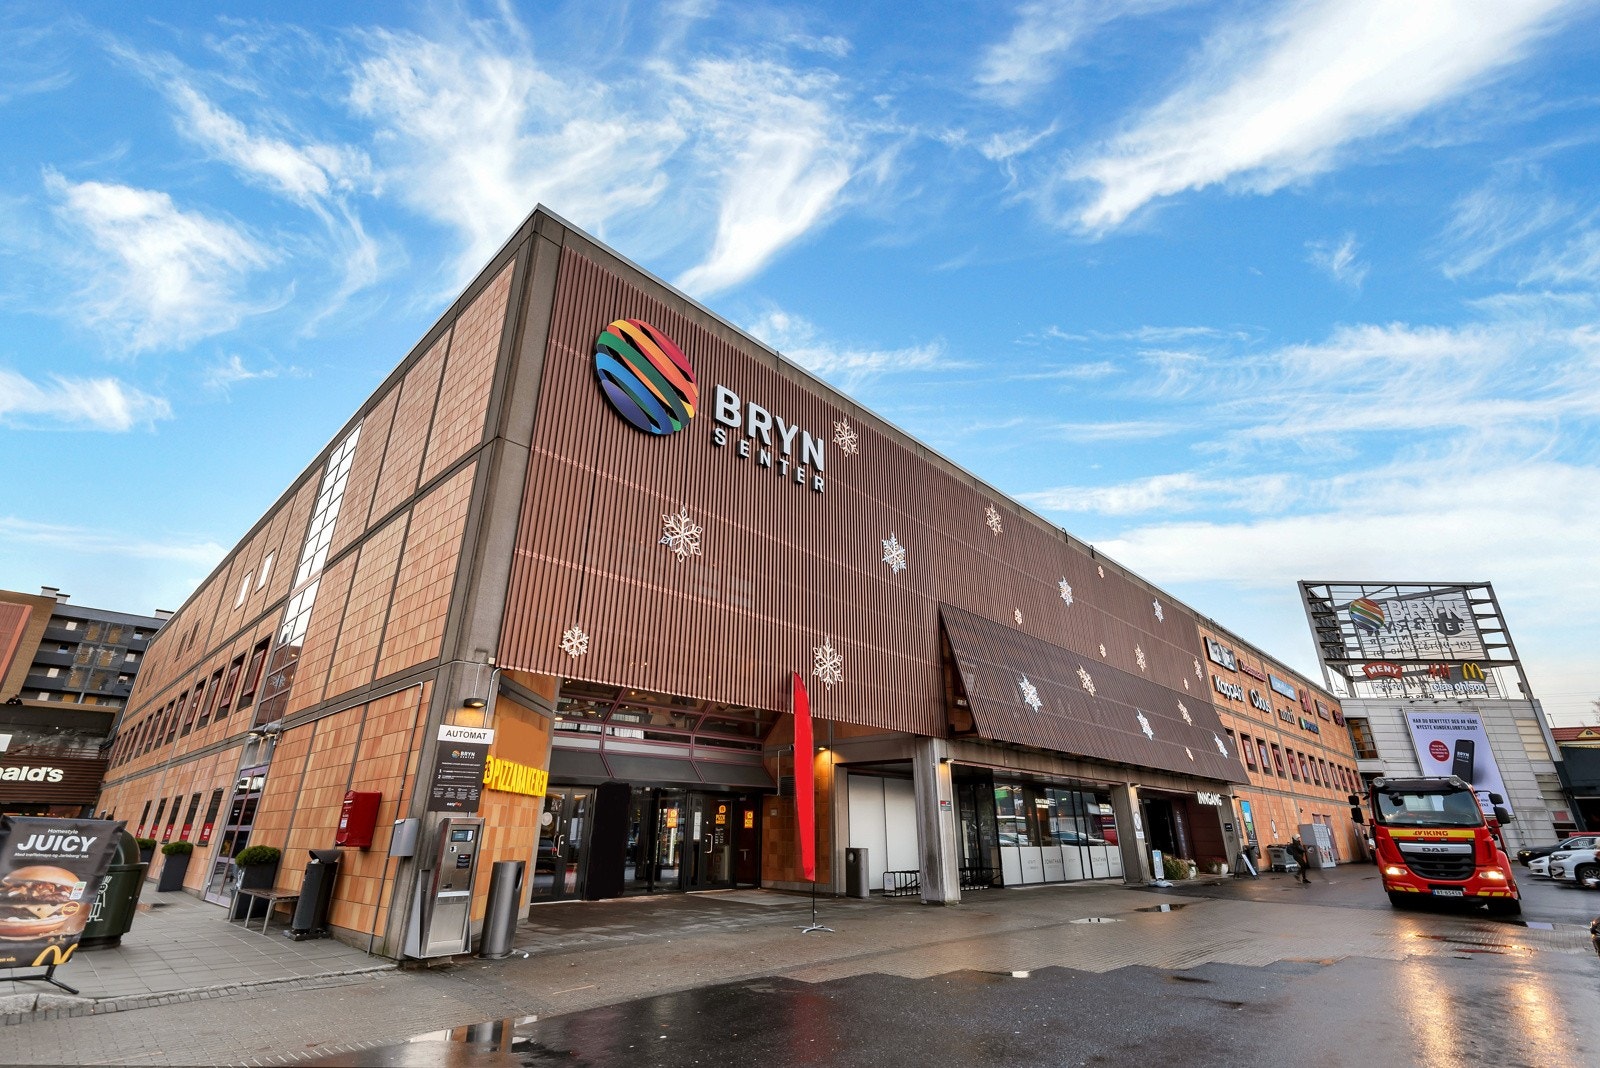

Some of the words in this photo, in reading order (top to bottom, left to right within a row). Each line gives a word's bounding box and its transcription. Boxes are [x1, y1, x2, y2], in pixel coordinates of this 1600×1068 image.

[714, 384, 824, 472] BRYN
[712, 427, 824, 493] SENTER
[1386, 600, 1463, 620] BRYN
[1367, 664, 1399, 675] MENY
[445, 729, 488, 740] AUTOMAT
[0, 766, 64, 782] ald's
[491, 758, 549, 797] PIZZABAKEREN
[1197, 791, 1222, 806] INNGANG
[17, 834, 98, 852] JUICY
